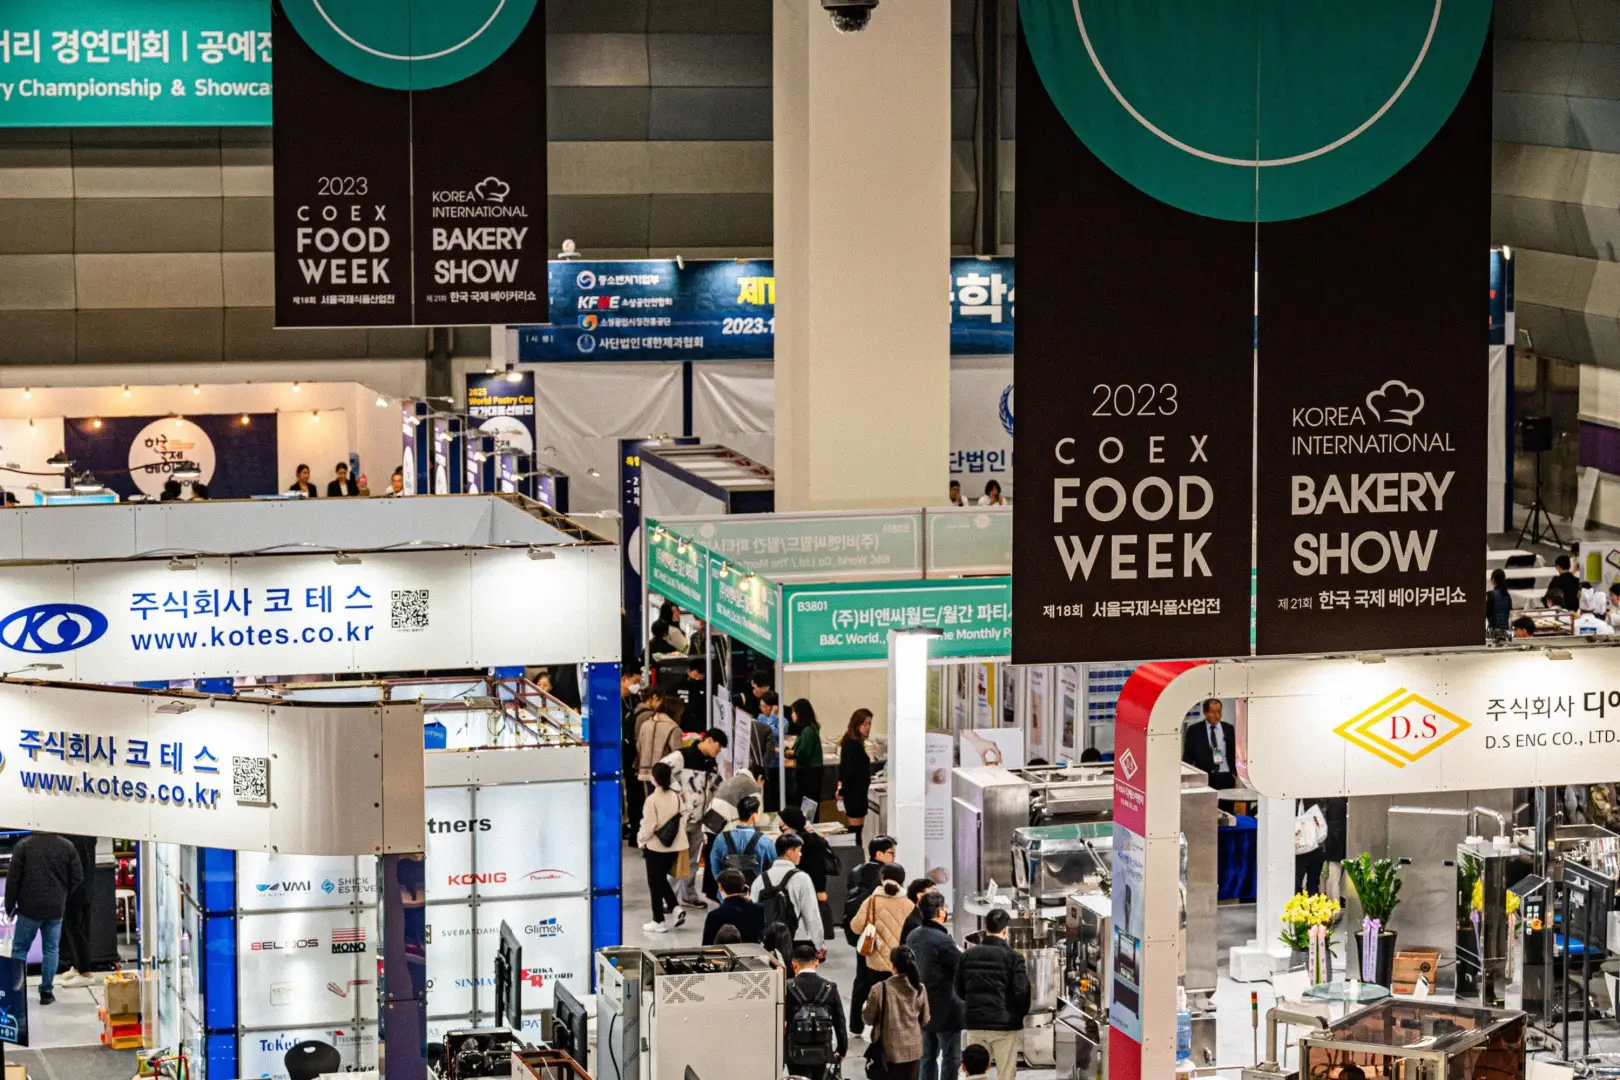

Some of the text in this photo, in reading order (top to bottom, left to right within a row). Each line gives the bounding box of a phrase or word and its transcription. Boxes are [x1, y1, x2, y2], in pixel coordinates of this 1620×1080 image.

[51, 29, 169, 63] 경연대회
[19, 78, 162, 101] Championship
[171, 79, 186, 97] &
[317, 176, 369, 196] 2023
[432, 190, 476, 203] KOREA
[297, 205, 387, 222] COEX
[432, 205, 529, 218] INTERNATIONAL
[296, 227, 391, 253] FOOD
[432, 226, 529, 251] BAKERY
[298, 258, 391, 285] WEEK
[433, 258, 520, 285] SHOW
[450, 291, 469, 304] 한국
[470, 290, 490, 303] 국제
[490, 289, 537, 302] 베이커리쇼
[599, 336, 640, 350] 사단법인
[1091, 382, 1179, 417] 2023
[1292, 406, 1366, 427] KOREA
[1054, 434, 1209, 465] COEX
[1292, 432, 1456, 456] INTERNATIONAL
[1053, 475, 1214, 523] FOOD
[1291, 471, 1456, 516] BAKERY
[1053, 532, 1213, 582] WEEK
[1292, 529, 1439, 576] SHOW
[130, 587, 252, 621] 주식회사
[797, 601, 829, 613] B3801
[1043, 598, 1221, 618] 제18회 서울국제식품산업전
[1318, 589, 1351, 610] 한국
[1353, 588, 1385, 609] 국제
[1389, 587, 1467, 608] 베이커리쇼
[976, 603, 1012, 623] 파티
[131, 621, 374, 651] www.kotes.co.kr
[819, 633, 843, 647] B&C
[956, 628, 1001, 641] Monthly
[1003, 627, 1012, 638] P
[1486, 695, 1576, 722] 주식회사
[1390, 714, 1438, 740] D.S
[18, 728, 116, 767] 주식회사
[1485, 733, 1510, 749] D.S
[1516, 732, 1547, 748] ENG
[1589, 729, 1620, 744] LTD.
[20, 768, 220, 806] www.kotes.co.kr
[427, 816, 492, 834] tners
[282, 881, 311, 892] VMI
[338, 877, 369, 886] SHICK
[525, 923, 565, 935] Glimek
[332, 941, 366, 954] MONO
